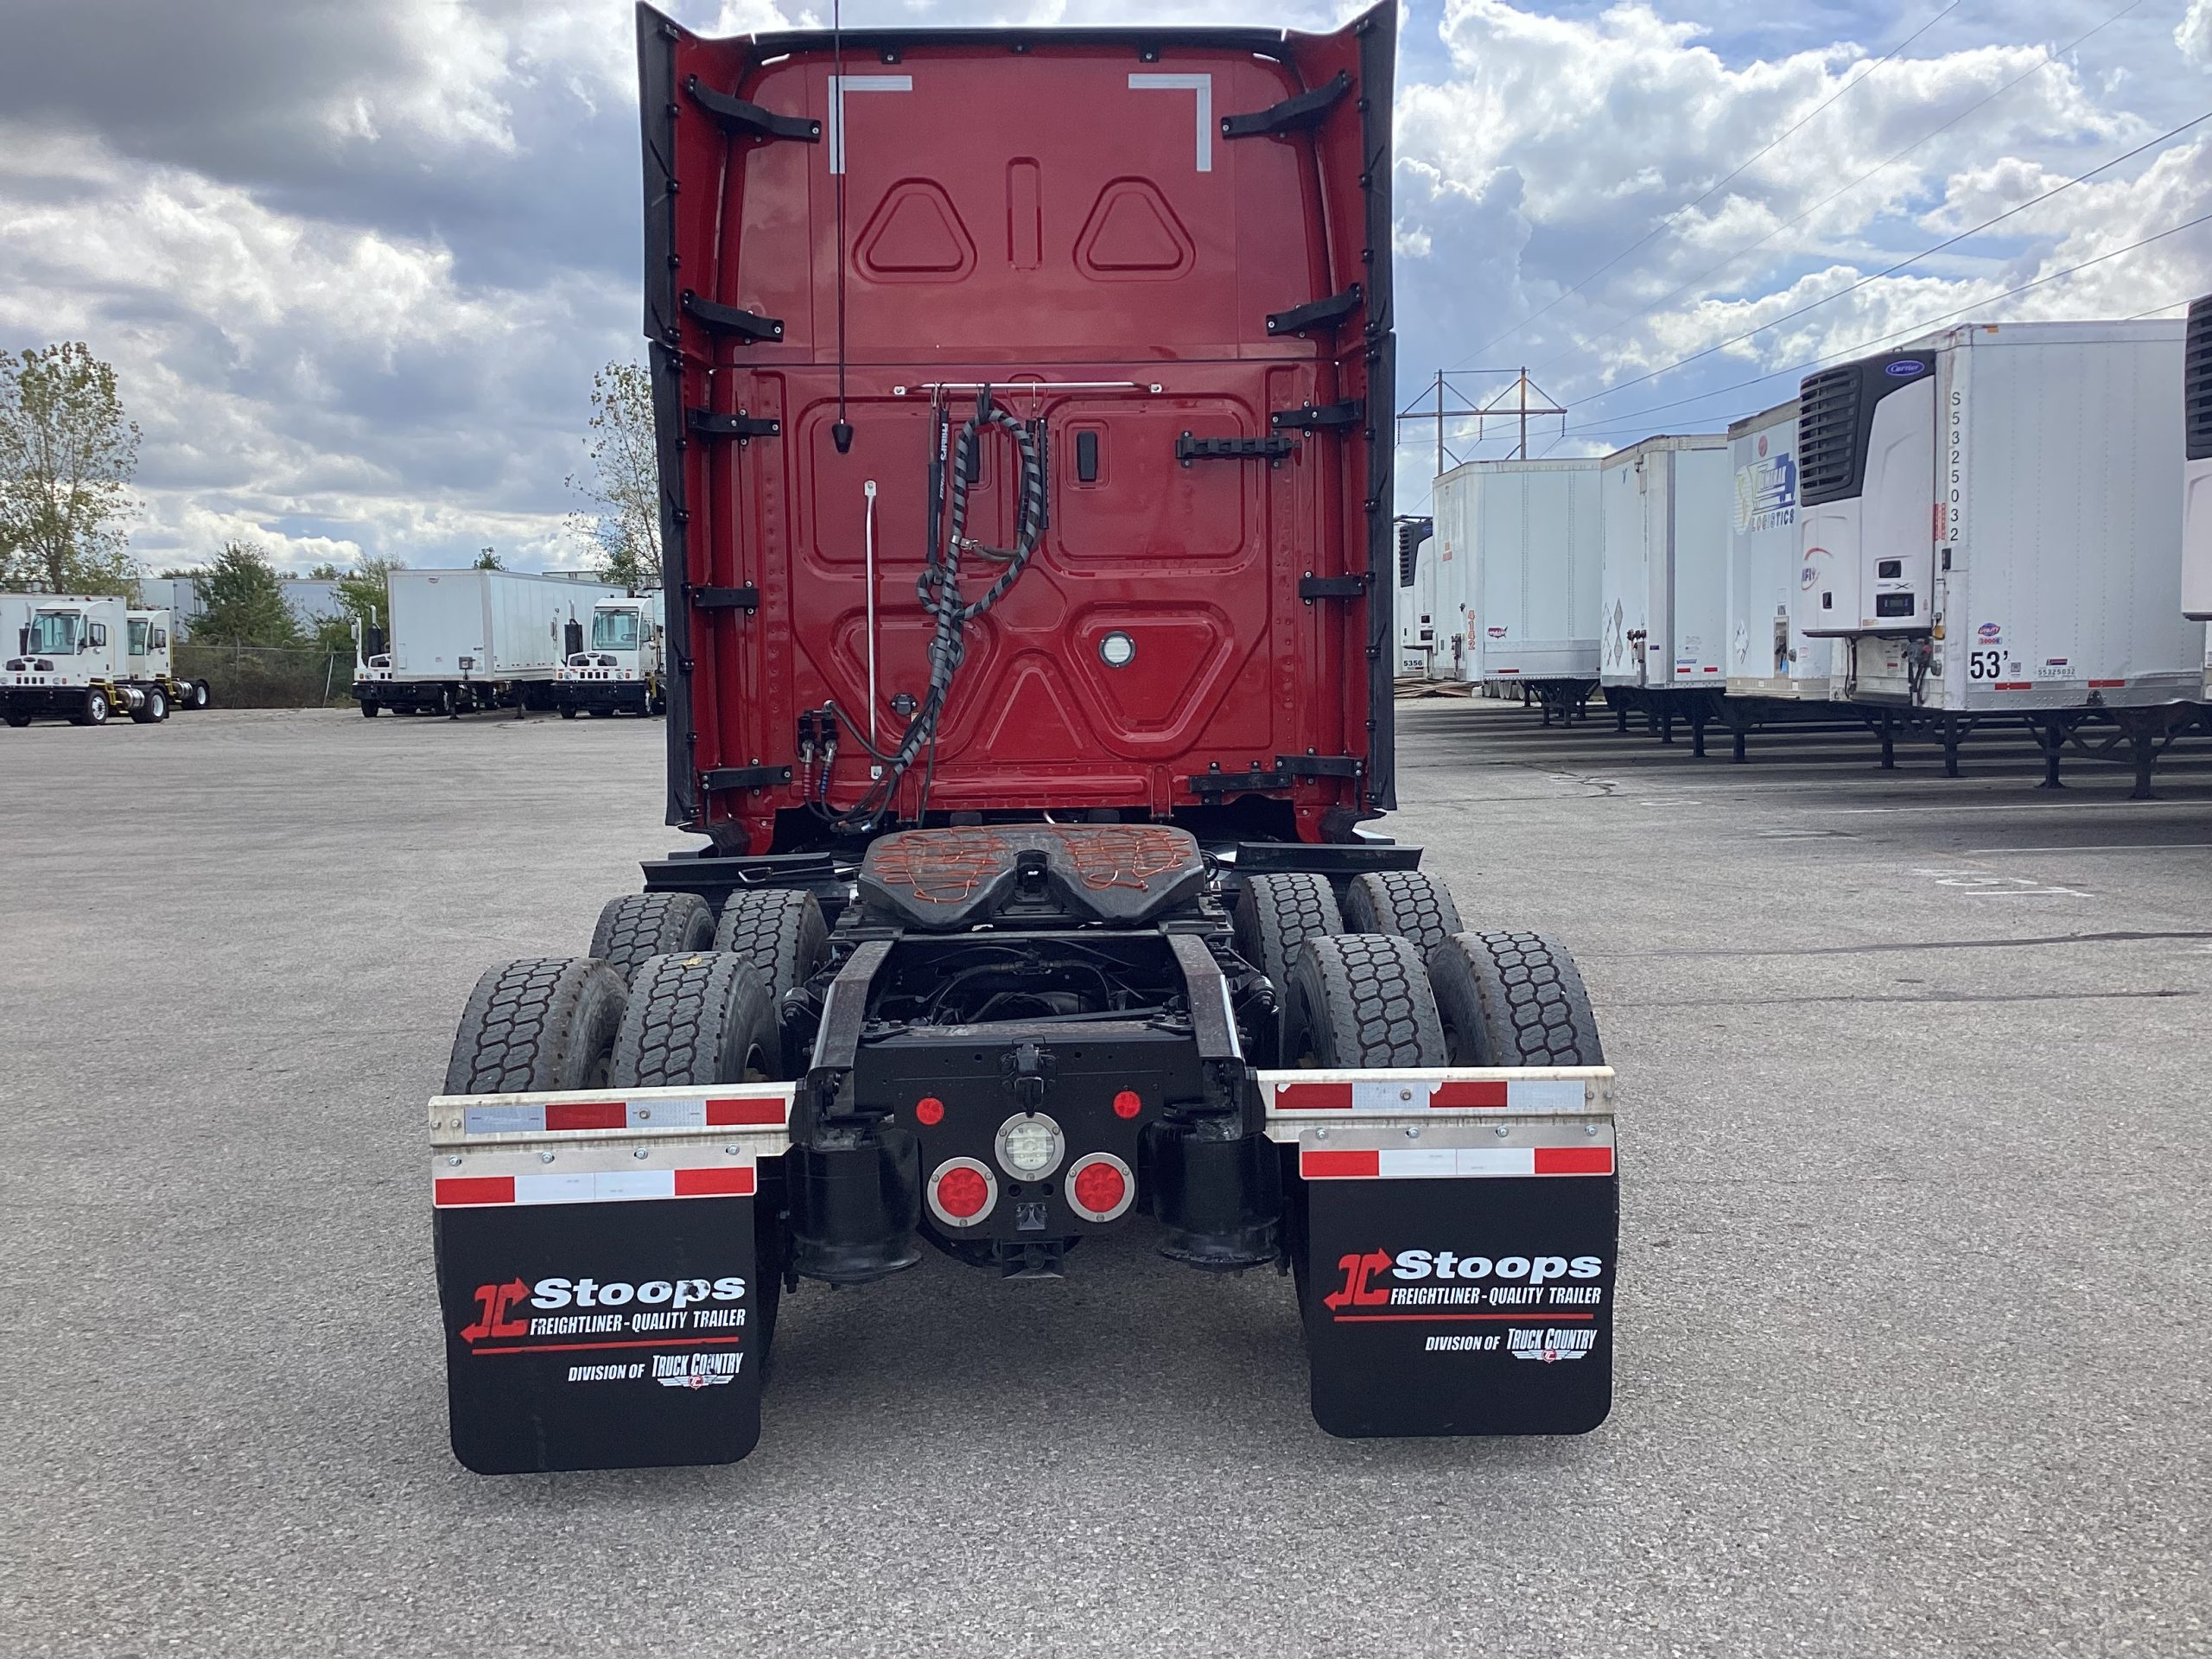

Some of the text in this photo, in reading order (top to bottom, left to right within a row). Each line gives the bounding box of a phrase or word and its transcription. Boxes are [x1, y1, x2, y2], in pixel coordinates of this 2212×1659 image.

[1891, 364, 1919, 372] Carrier
[1750, 508, 1795, 531] LOGISTICS
[1467, 610, 1476, 650] 4142
[1392, 1249, 1602, 1284] Stoops
[531, 1277, 746, 1309] Stoops
[1548, 1287, 1601, 1305] TRAILER
[693, 1309, 746, 1328] TRAILER
[1425, 1328, 1598, 1351] DIVISION OF TRUCK COUNTRY
[569, 1364, 626, 1382] DIVISION
[628, 1363, 645, 1379] OF
[652, 1354, 690, 1377] TRUCK
